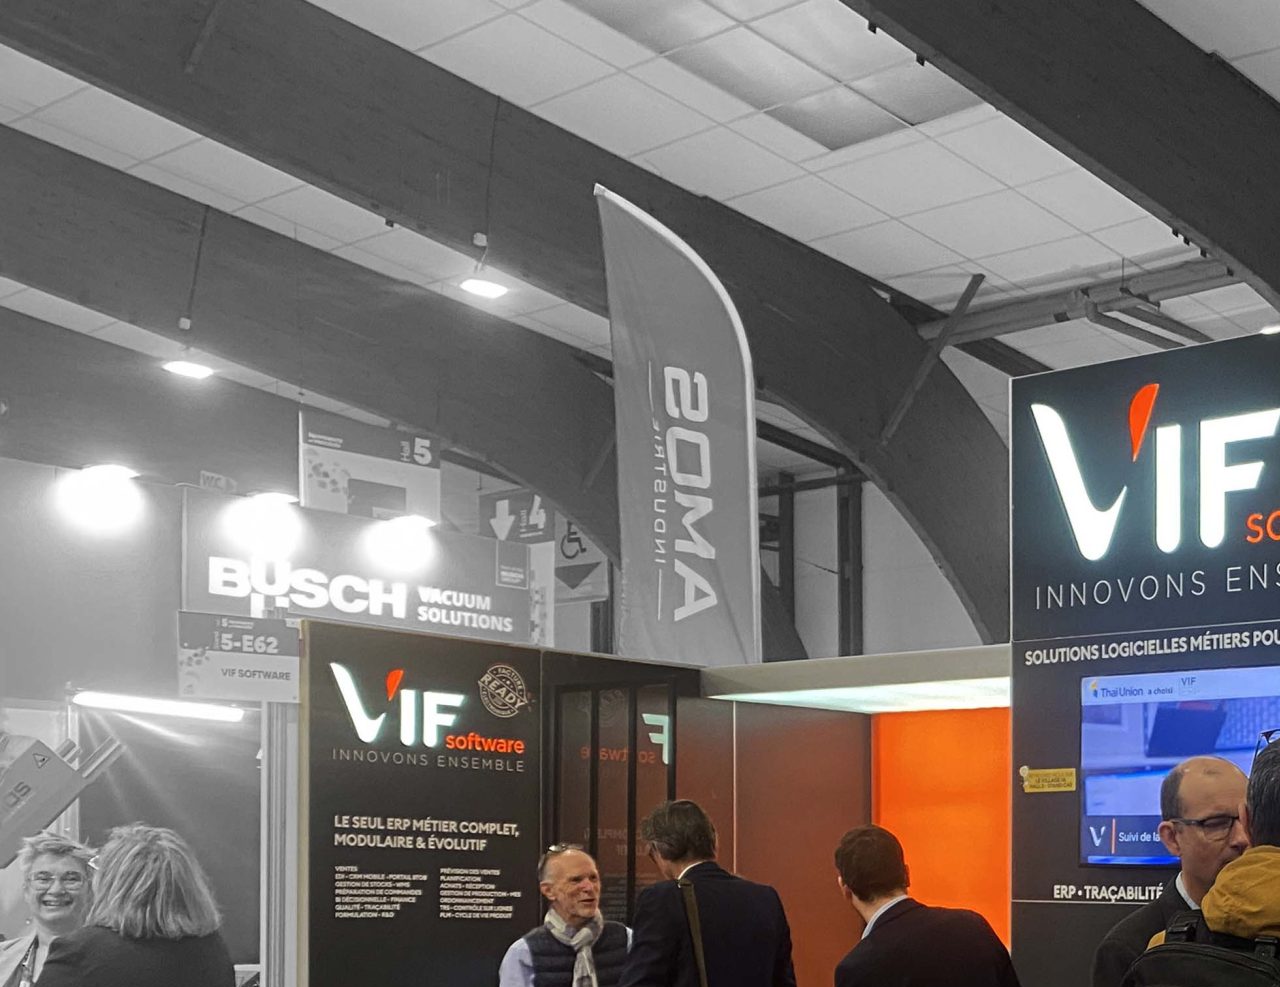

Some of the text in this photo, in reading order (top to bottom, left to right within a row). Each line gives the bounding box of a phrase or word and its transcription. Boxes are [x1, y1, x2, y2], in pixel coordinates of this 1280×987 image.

[413, 437, 432, 465] 5
[208, 556, 407, 618] BUSCH
[417, 586, 491, 610] VACUUM
[1035, 570, 1207, 610] INNOVONS
[417, 606, 513, 632] SOLUTIONS
[221, 633, 280, 654] 5-E62
[1025, 644, 1099, 666] SOLUTIONS
[1102, 636, 1188, 659] LOGICIELLES
[1190, 630, 1250, 652] MÉTIERS
[221, 668, 292, 681] VIF SOFTWARE
[1181, 677, 1197, 686] VIF
[479, 673, 526, 709] READY
[1119, 688, 1144, 697] Union
[329, 662, 465, 748] VIF
[445, 732, 525, 754] software
[332, 748, 525, 772] INNOVONS ENSEMBLE
[334, 815, 519, 838] LE SEUL ERP MÉTIER COMPLET,
[1118, 832, 1139, 842] Suivi
[1140, 832, 1151, 842] de
[334, 833, 487, 851] MODULAIRE & ÉVOLUTIF
[1053, 884, 1076, 899] ERP
